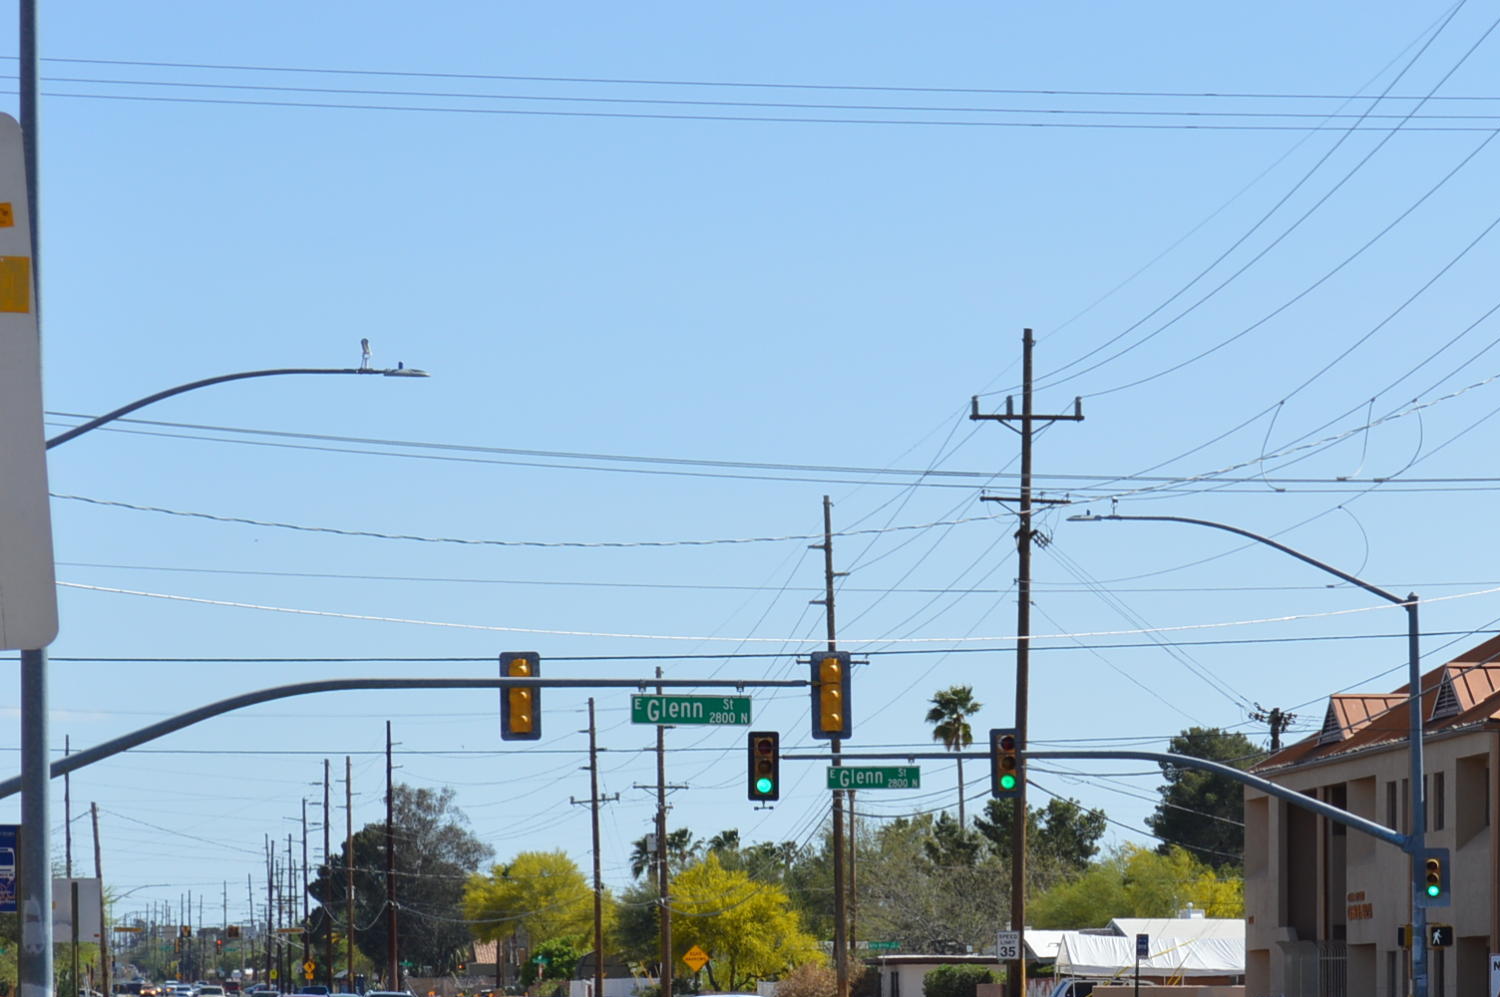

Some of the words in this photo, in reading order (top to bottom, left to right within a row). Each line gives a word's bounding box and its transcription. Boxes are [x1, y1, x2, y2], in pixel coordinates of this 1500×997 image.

[634, 698, 642, 710] E
[647, 698, 703, 722] Glenn
[722, 698, 734, 710] St
[708, 711, 736, 724] 2800
[741, 712, 748, 724] N
[829, 769, 836, 779] E
[840, 768, 883, 787] Glenn
[898, 767, 907, 777] St
[887, 779, 909, 788] 2800
[912, 778, 918, 788] N
[1000, 946, 1016, 957] 35
